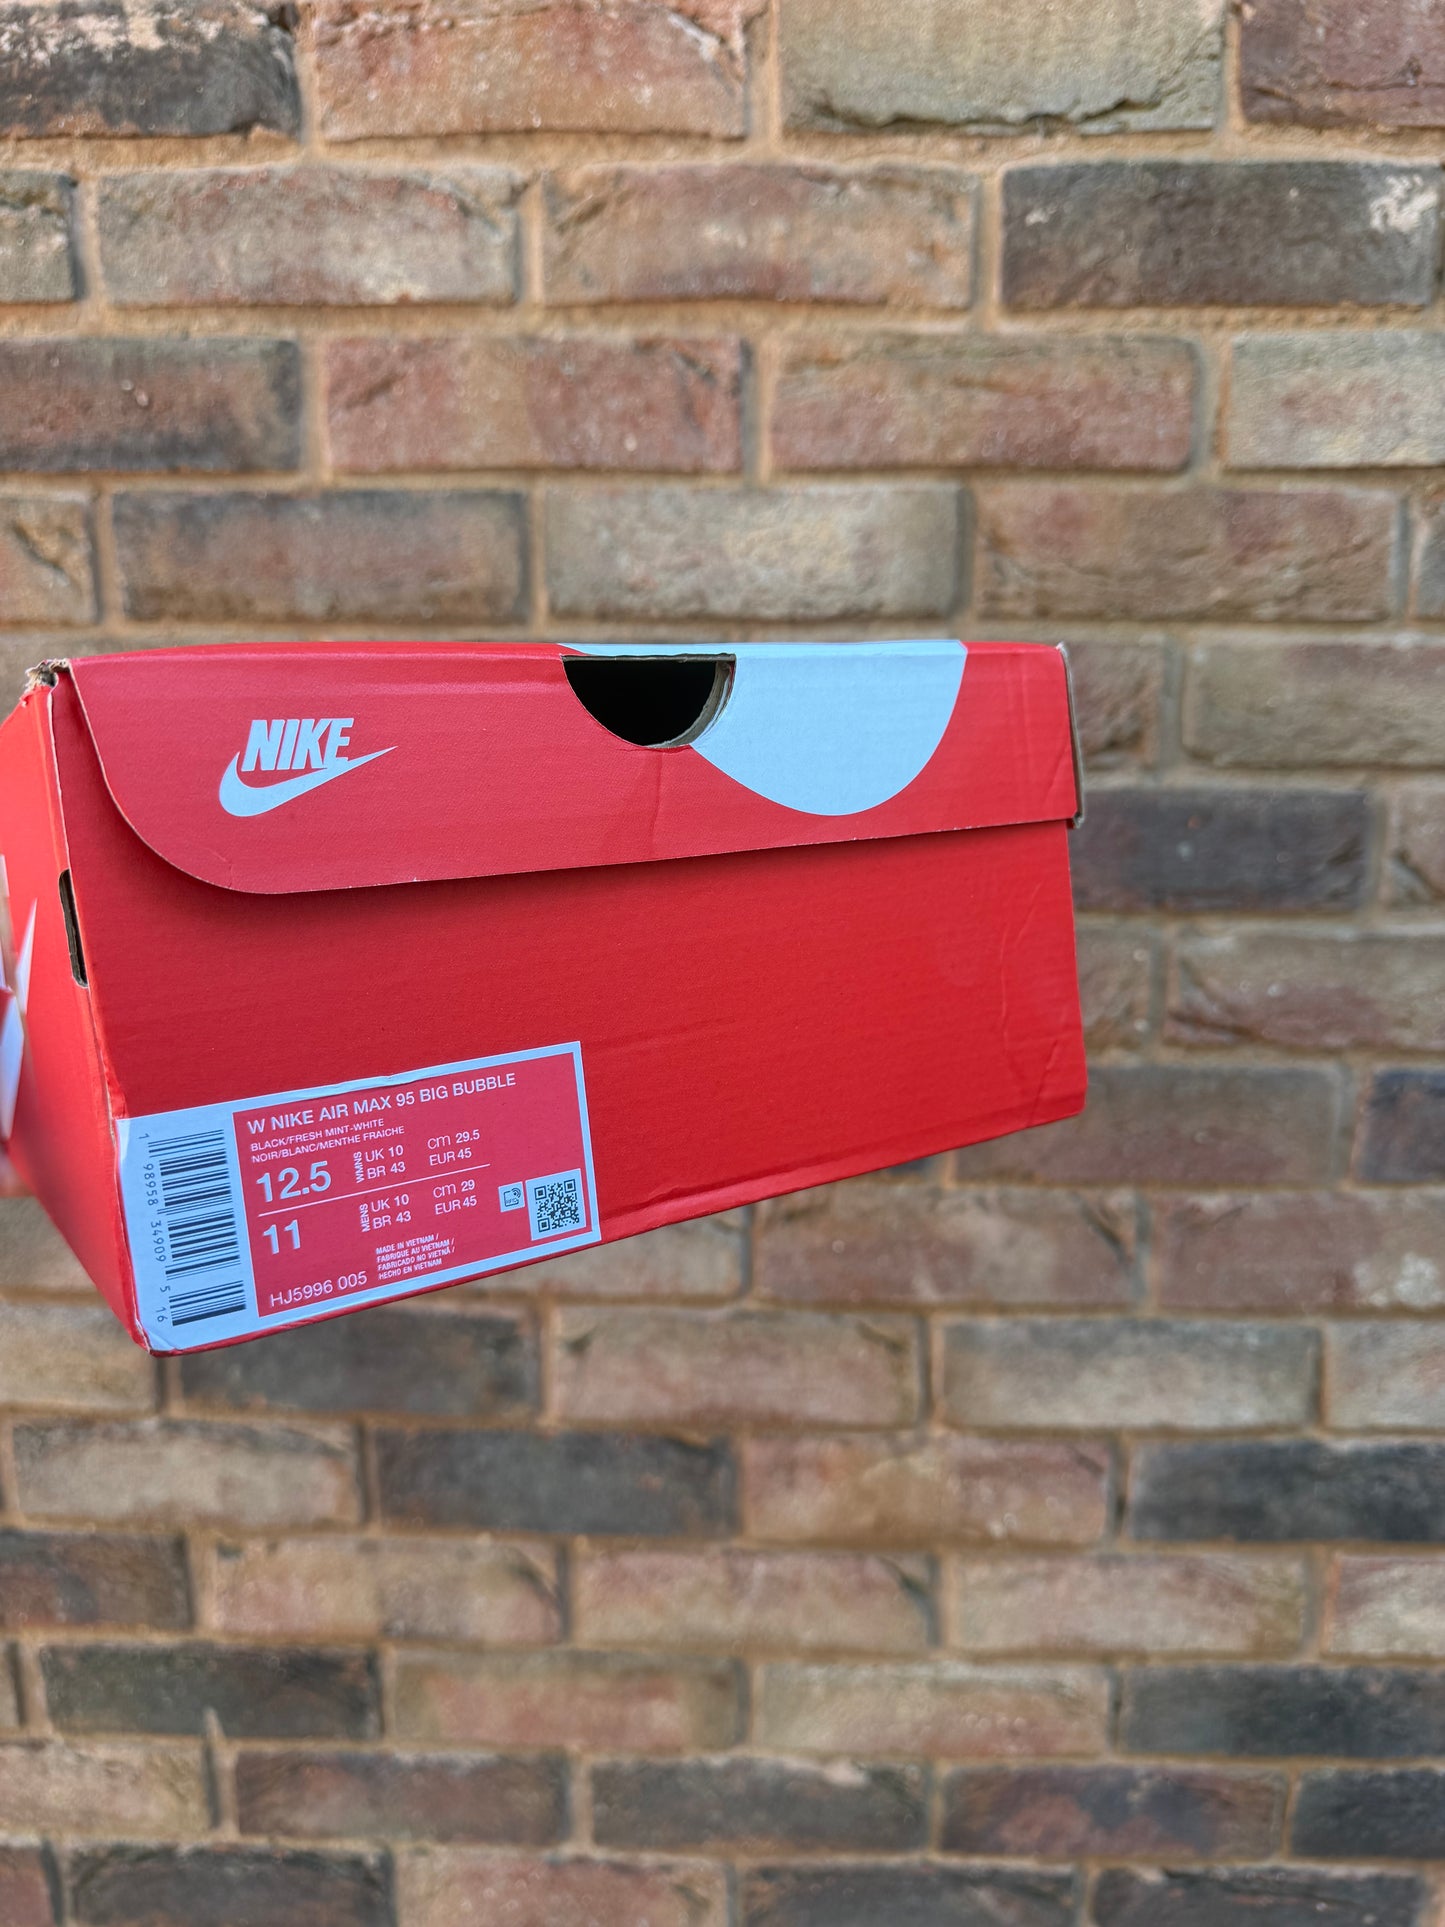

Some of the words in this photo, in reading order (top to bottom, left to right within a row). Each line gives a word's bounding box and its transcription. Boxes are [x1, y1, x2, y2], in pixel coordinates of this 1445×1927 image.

[241, 718, 354, 772] NIKE
[248, 1119, 265, 1134] W
[271, 1110, 314, 1131] NIKE
[319, 1104, 348, 1121] AIR
[353, 1096, 391, 1115] MAX
[396, 1091, 415, 1107] 95
[419, 1086, 449, 1102] BIG
[452, 1073, 516, 1096] BUBBLE
[250, 1130, 322, 1152] BLACK/FRESH
[325, 1118, 384, 1137] MINT-WHITE
[252, 1136, 360, 1163] NOIR/BLANC/MENTHE
[364, 1126, 404, 1141] FRAICHE
[455, 1129, 480, 1144] 29.5
[365, 1148, 384, 1162] UK
[388, 1145, 404, 1157] 10
[429, 1151, 455, 1166] EUR
[457, 1148, 472, 1159] 45
[353, 1151, 364, 1183] WMNS
[367, 1166, 386, 1179] BR
[390, 1162, 406, 1173] 43
[143, 1163, 159, 1206] 98958
[256, 1160, 331, 1202] 12.5
[461, 1180, 475, 1192] 29
[370, 1198, 390, 1212] UK
[394, 1194, 409, 1206] 10
[435, 1200, 461, 1215] EUR
[463, 1195, 477, 1207] 45
[359, 1203, 371, 1232] MENS
[372, 1215, 392, 1229] BR
[396, 1211, 411, 1223] 43
[150, 1220, 167, 1263] 34909
[262, 1219, 300, 1255] 11
[375, 1244, 395, 1254] MADE
[406, 1234, 434, 1247] VIETNAM
[377, 1249, 409, 1262] FABRIQUE
[411, 1246, 420, 1254] AU
[421, 1239, 450, 1252] VIETNAM
[378, 1257, 415, 1271] FABRICADO
[378, 1268, 401, 1280] HECHO
[403, 1265, 412, 1273] EN
[414, 1258, 442, 1270] VIETNAM
[270, 1280, 333, 1307] HJ5996
[337, 1271, 367, 1290] 005
[155, 1306, 168, 1323] 16
